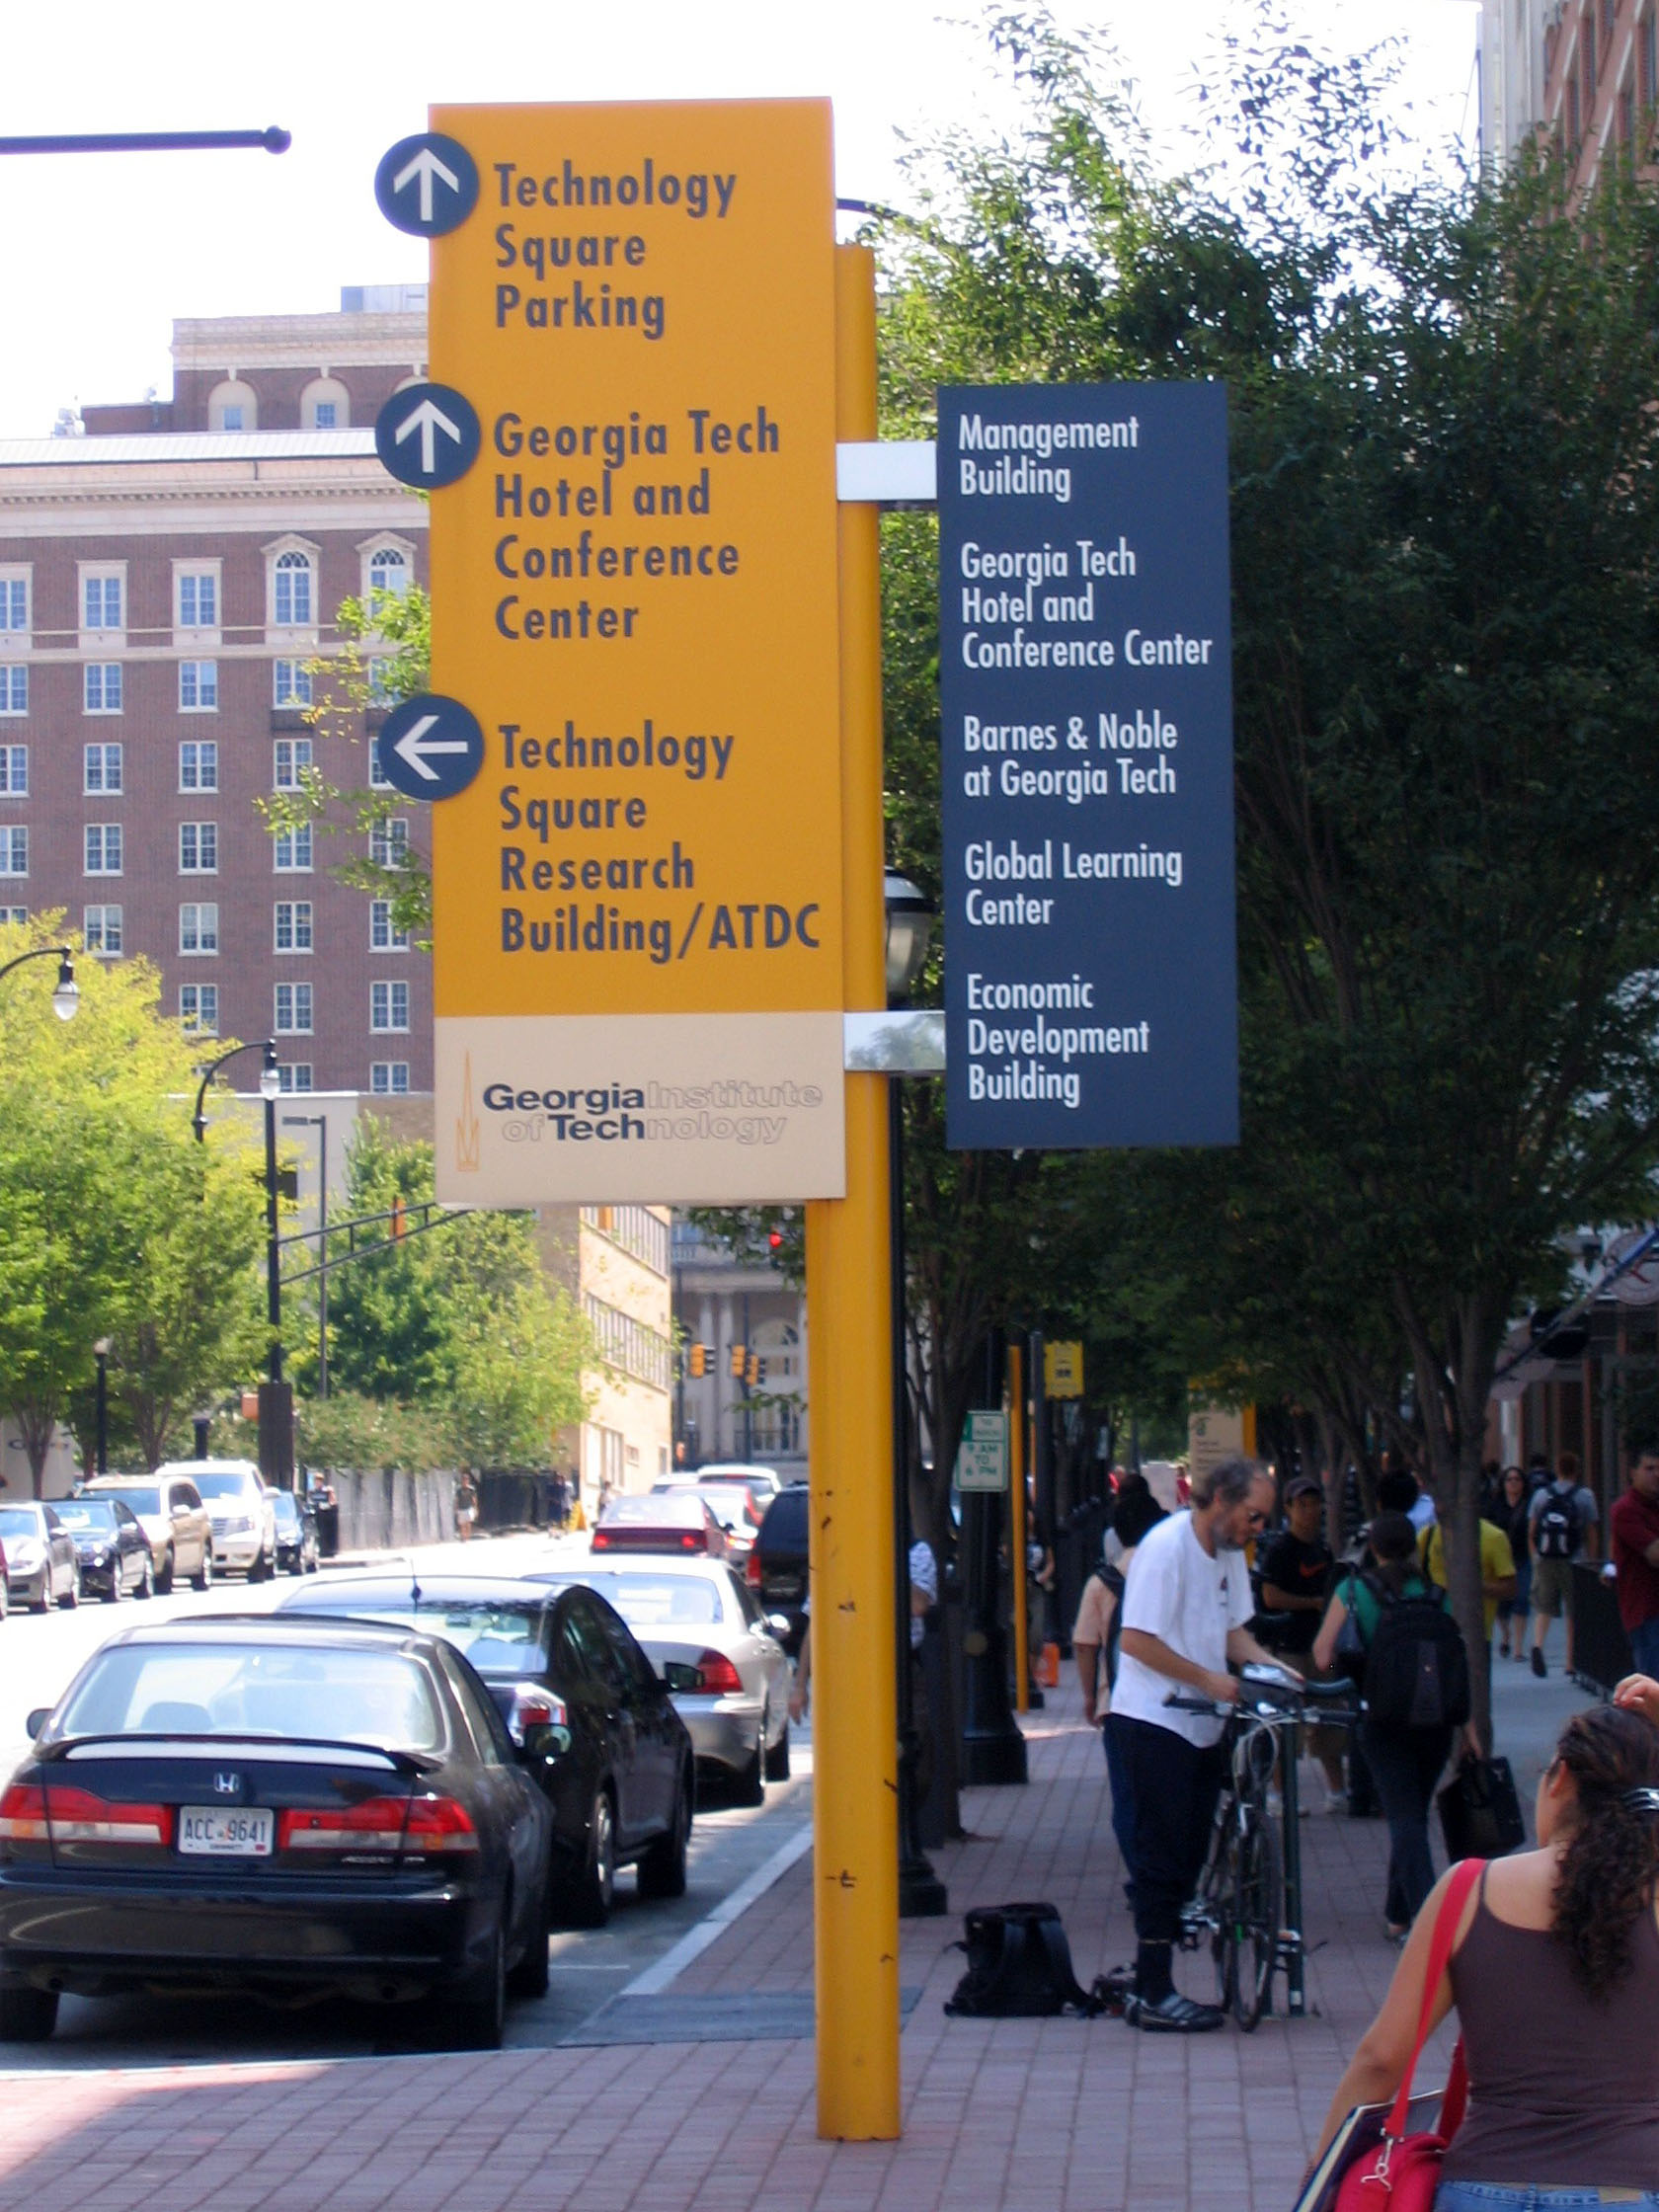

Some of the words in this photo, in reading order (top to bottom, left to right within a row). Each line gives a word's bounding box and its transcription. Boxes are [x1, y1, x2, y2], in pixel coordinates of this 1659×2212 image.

[494, 158, 736, 218] Technology
[494, 223, 645, 280] Square
[495, 280, 664, 340] Parking
[494, 412, 667, 469] Georgia
[687, 406, 778, 453] Tech
[959, 415, 1139, 457] Management
[494, 469, 612, 517] Hotel
[633, 468, 709, 515] and
[961, 455, 1070, 503] Building
[494, 530, 739, 579] Conference
[962, 542, 1068, 587] Georgia
[1076, 537, 1136, 576] Tech
[494, 595, 638, 640] Center
[963, 583, 1033, 622] Hotel
[1043, 582, 1093, 621] and
[963, 628, 1114, 668] Conference
[1125, 629, 1212, 665] Center
[498, 719, 734, 780] Technology
[965, 716, 1057, 750] Barnes
[1067, 717, 1088, 750] &
[1100, 709, 1177, 749] Noble
[965, 765, 990, 796] at
[1001, 759, 1107, 804] Georgia
[1117, 754, 1175, 793] Tech
[500, 785, 646, 843] Square
[501, 841, 694, 891] Research
[966, 840, 1052, 880] Global
[1064, 843, 1182, 886] Learning
[967, 889, 1054, 925] Center
[502, 903, 820, 965] Building/ATDC
[968, 974, 1093, 1009] Economic
[969, 1015, 1149, 1063] Development
[483, 1081, 644, 1115] Georgia
[647, 1080, 824, 1109] Institute
[970, 1061, 1079, 1108] Building
[502, 1113, 544, 1143] of
[547, 1111, 788, 1146] Technology
[981, 1443, 998, 1454] AM
[184, 1817, 214, 1841] ACC
[227, 1819, 266, 1843] 9641
